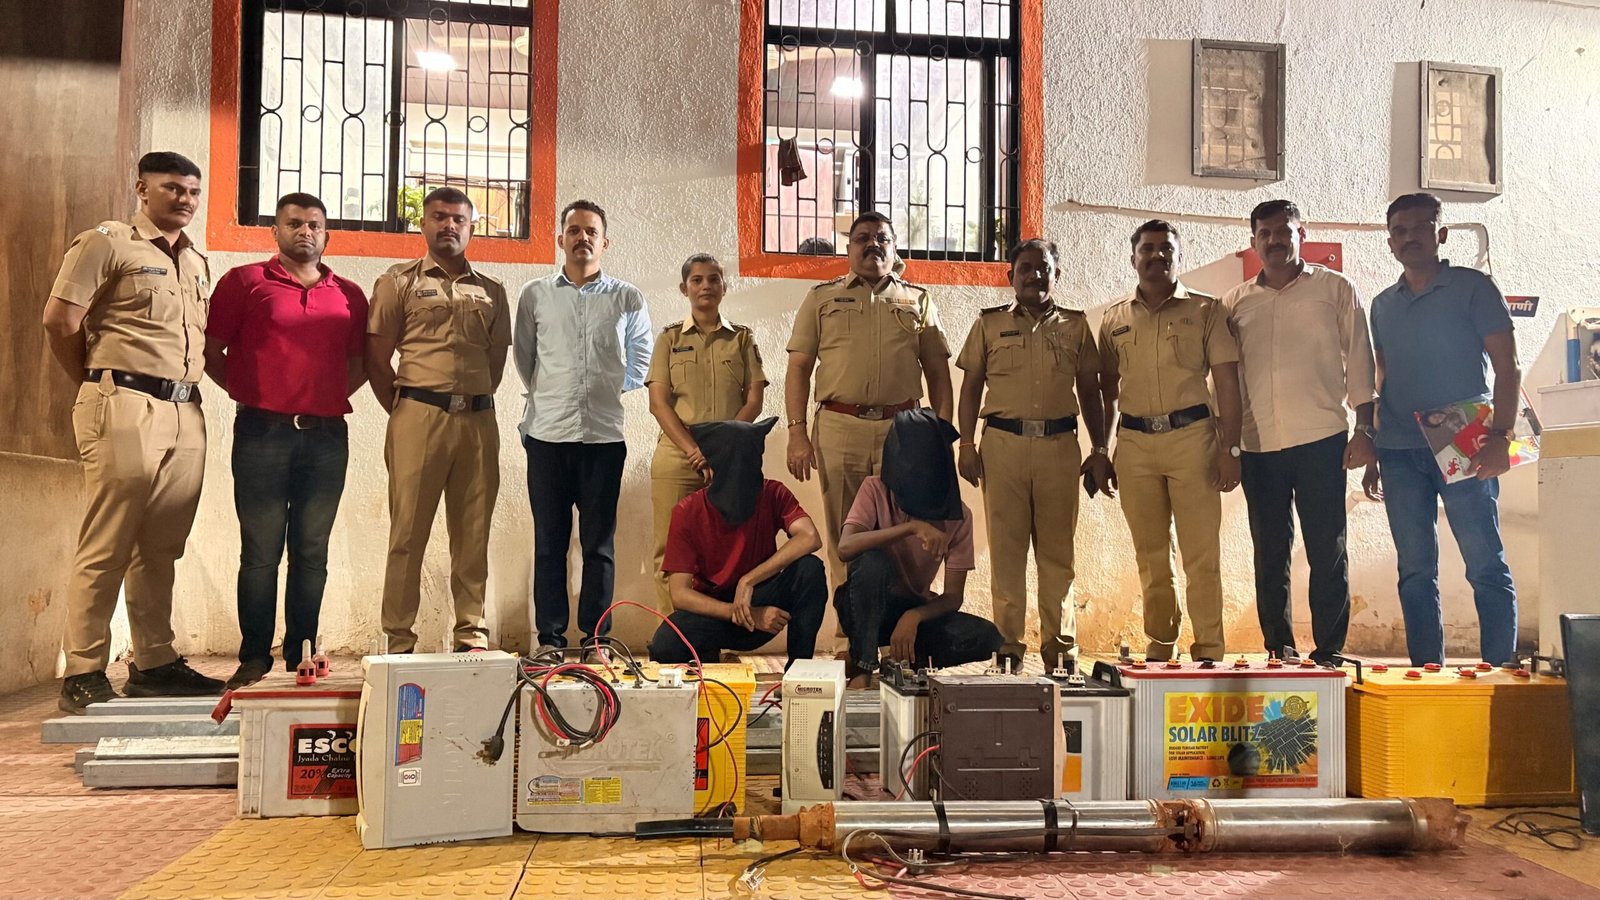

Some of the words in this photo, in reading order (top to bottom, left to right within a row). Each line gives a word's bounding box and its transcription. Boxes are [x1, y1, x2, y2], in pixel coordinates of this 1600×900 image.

[1169, 695, 1264, 723] EXIDE
[1169, 726, 1217, 743] SOLAR
[1221, 726, 1261, 742] BLITZ
[298, 755, 319, 763] Jyada
